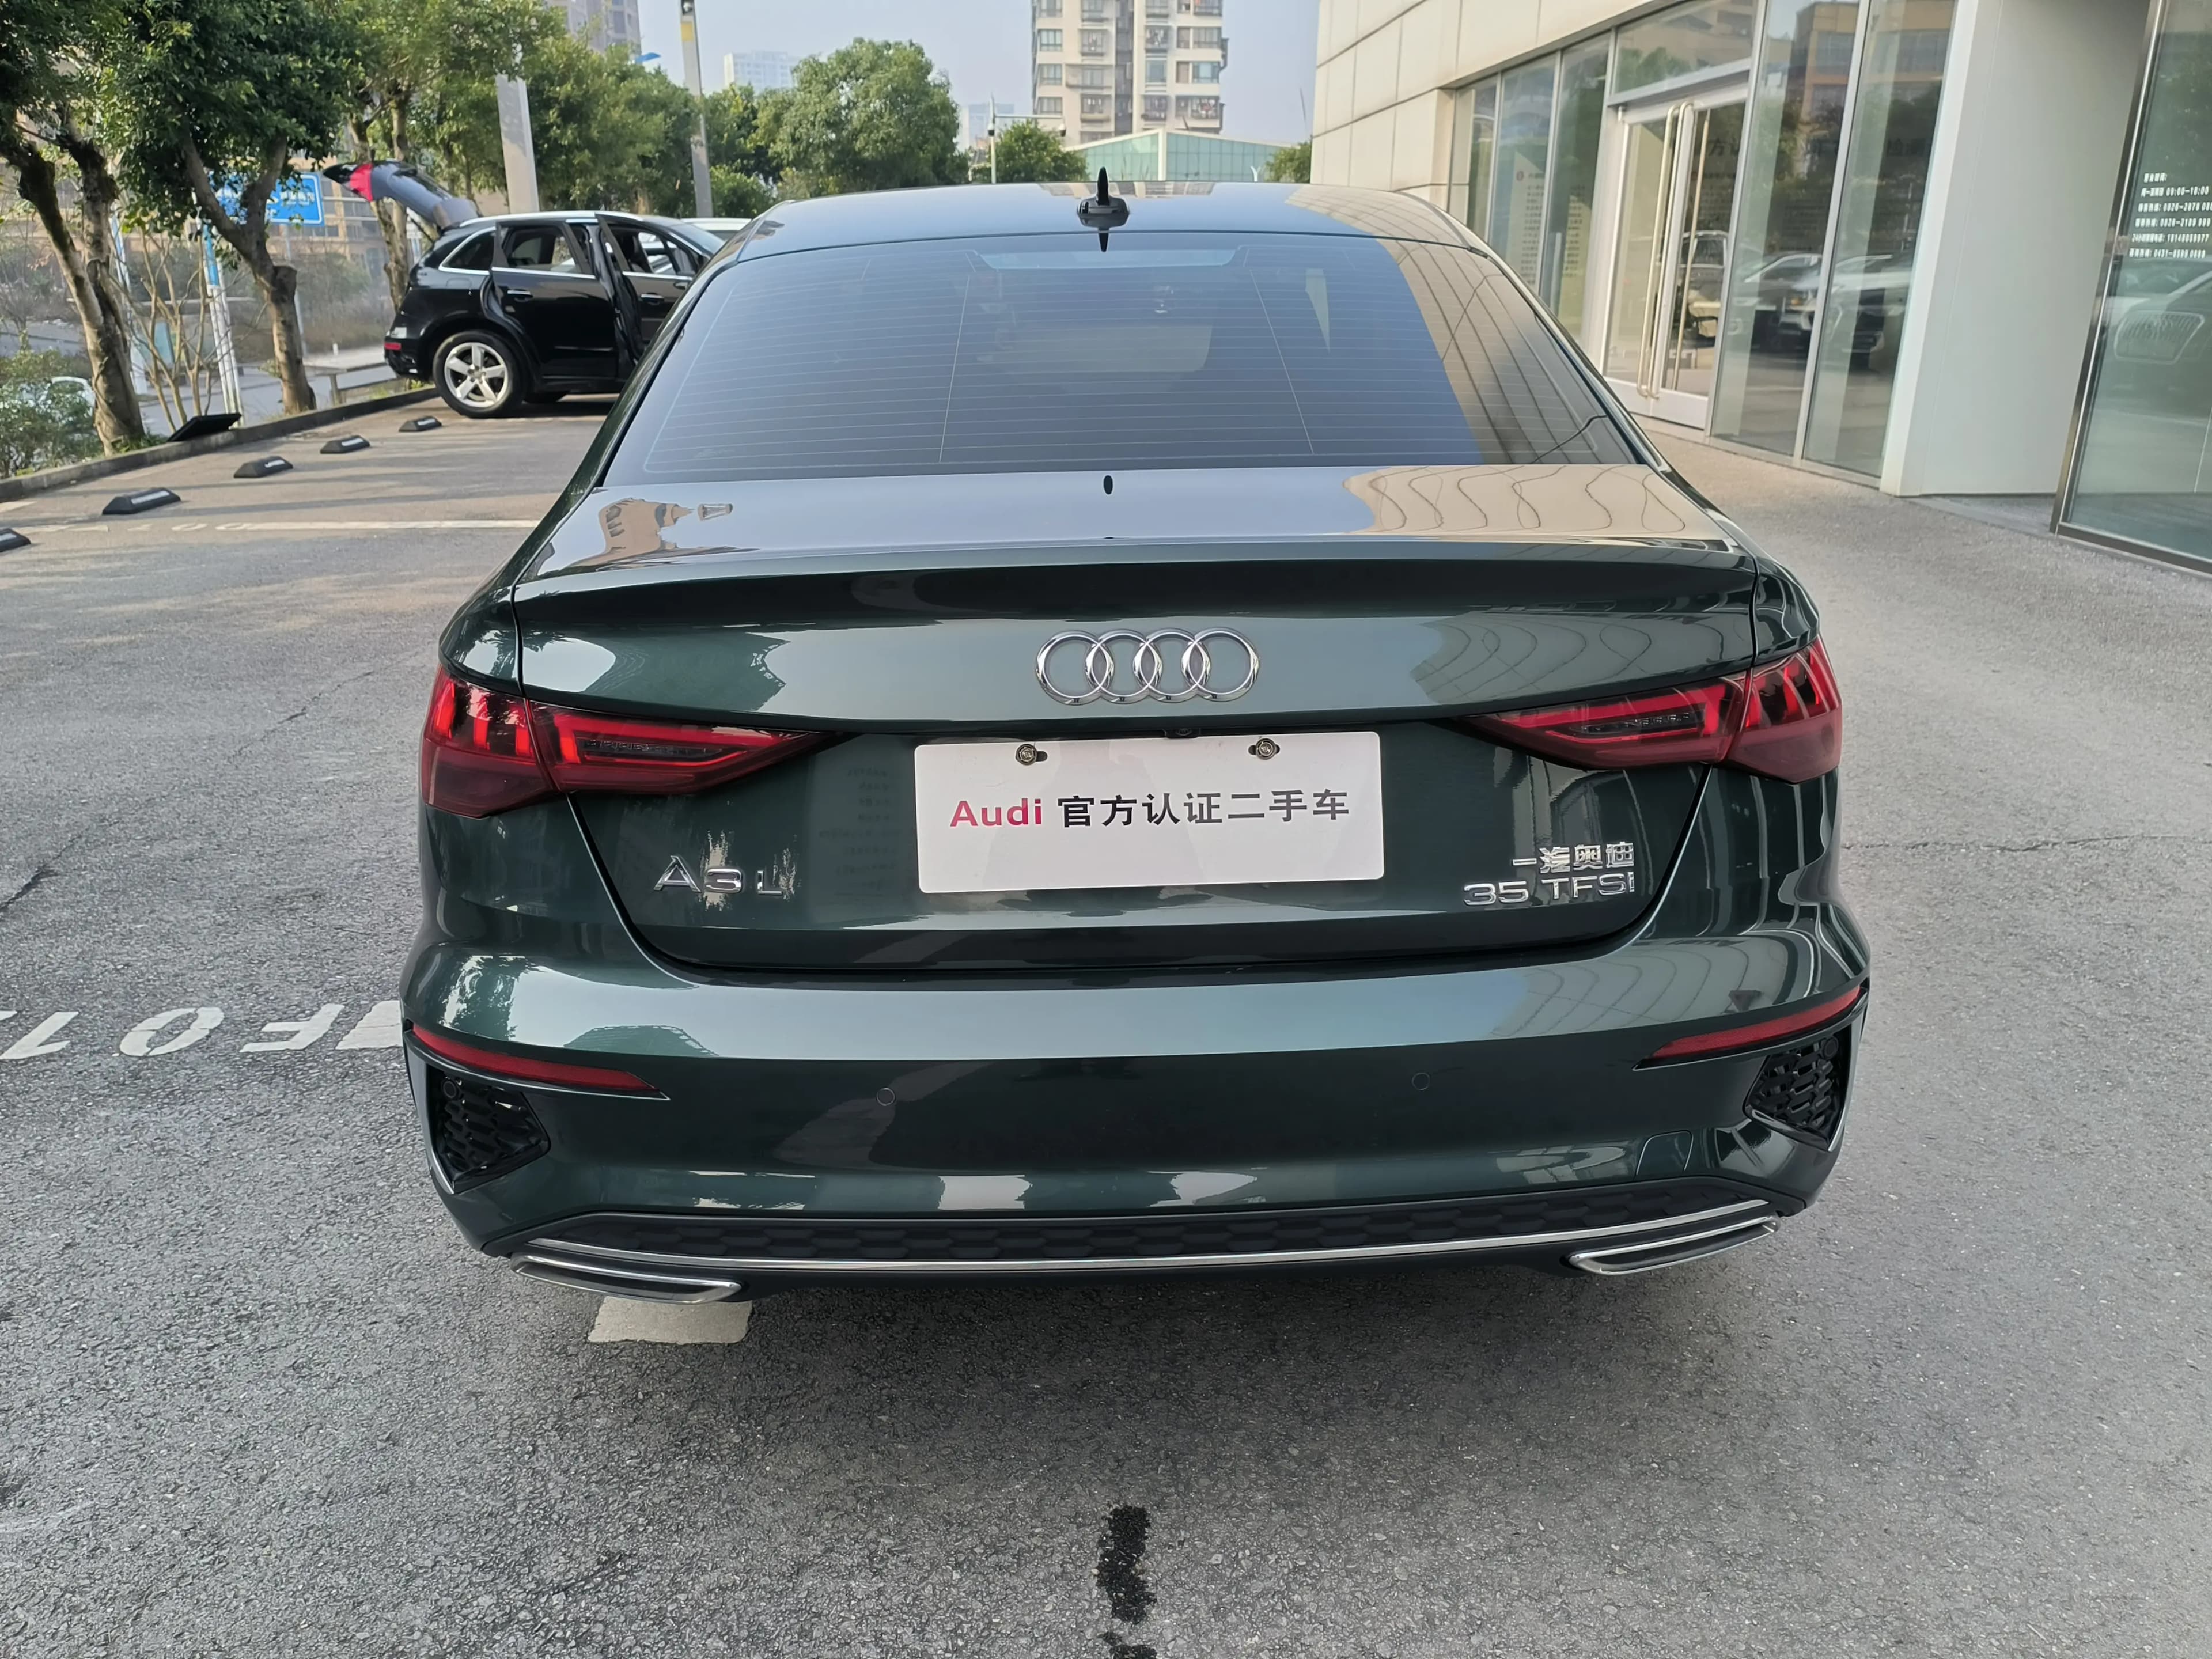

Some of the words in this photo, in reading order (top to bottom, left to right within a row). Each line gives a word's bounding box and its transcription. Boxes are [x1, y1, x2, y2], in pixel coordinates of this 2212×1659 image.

[950, 798, 1042, 827] Audi
[1057, 789, 1350, 828] 官方认证二手车
[653, 855, 743, 893] A3
[1512, 841, 1635, 874] 一汽奥迪
[1463, 881, 1529, 906] 35
[1540, 871, 1635, 899] TFSI
